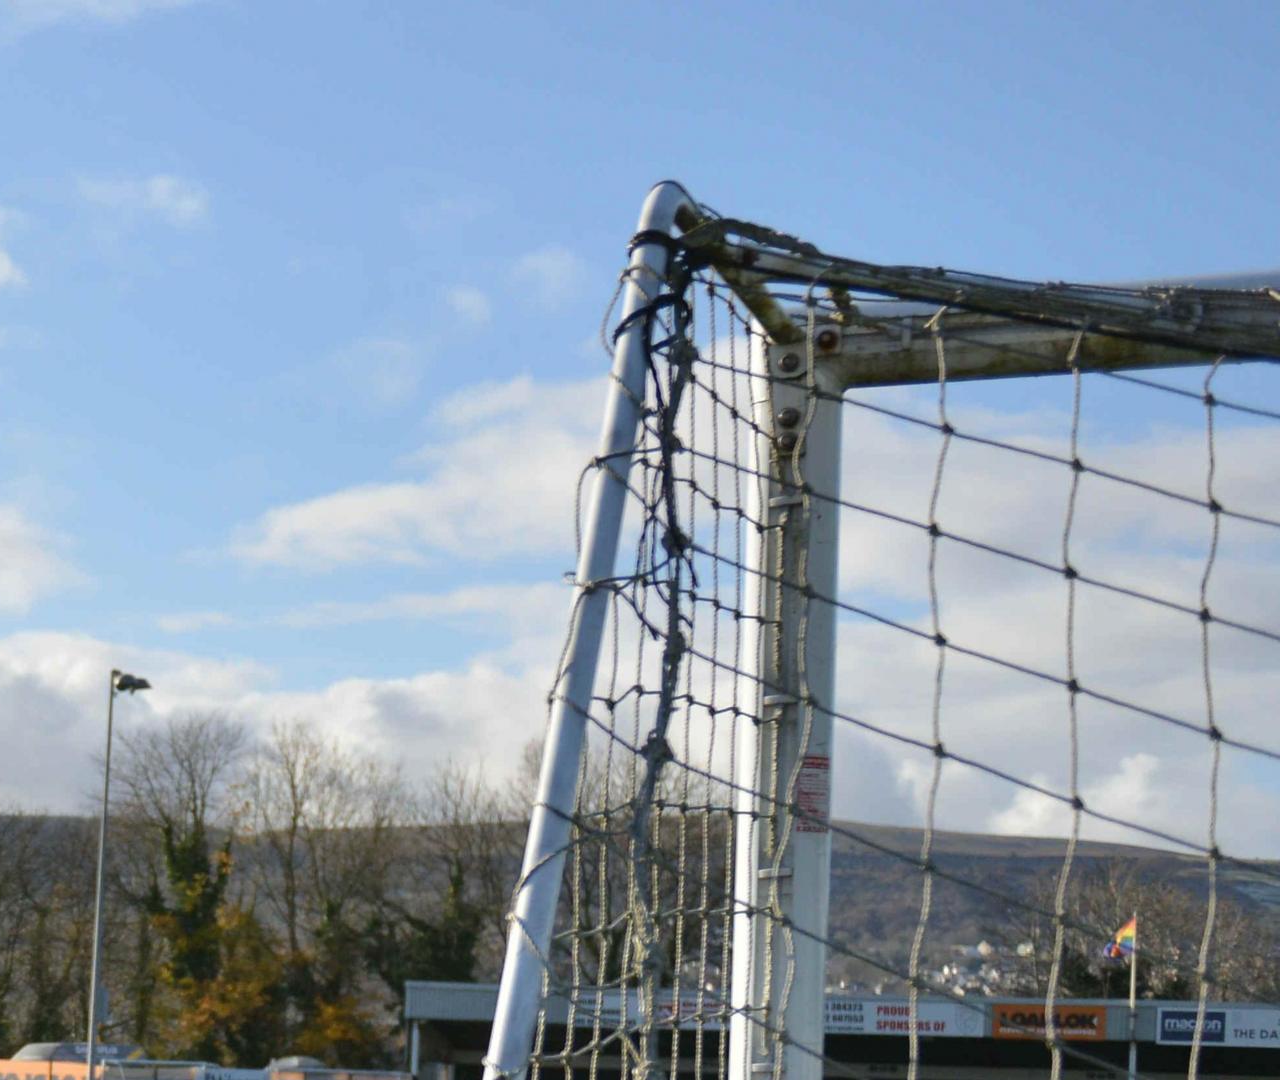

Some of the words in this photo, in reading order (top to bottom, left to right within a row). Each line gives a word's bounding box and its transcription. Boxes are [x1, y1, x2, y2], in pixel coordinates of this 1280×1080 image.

[876, 1019, 930, 1032] SPONSRS
[933, 1020, 945, 1032] OF
[1000, 1011, 1098, 1029] LOALOK
[1164, 1018, 1222, 1032] macon
[1233, 1029, 1256, 1039] THE
